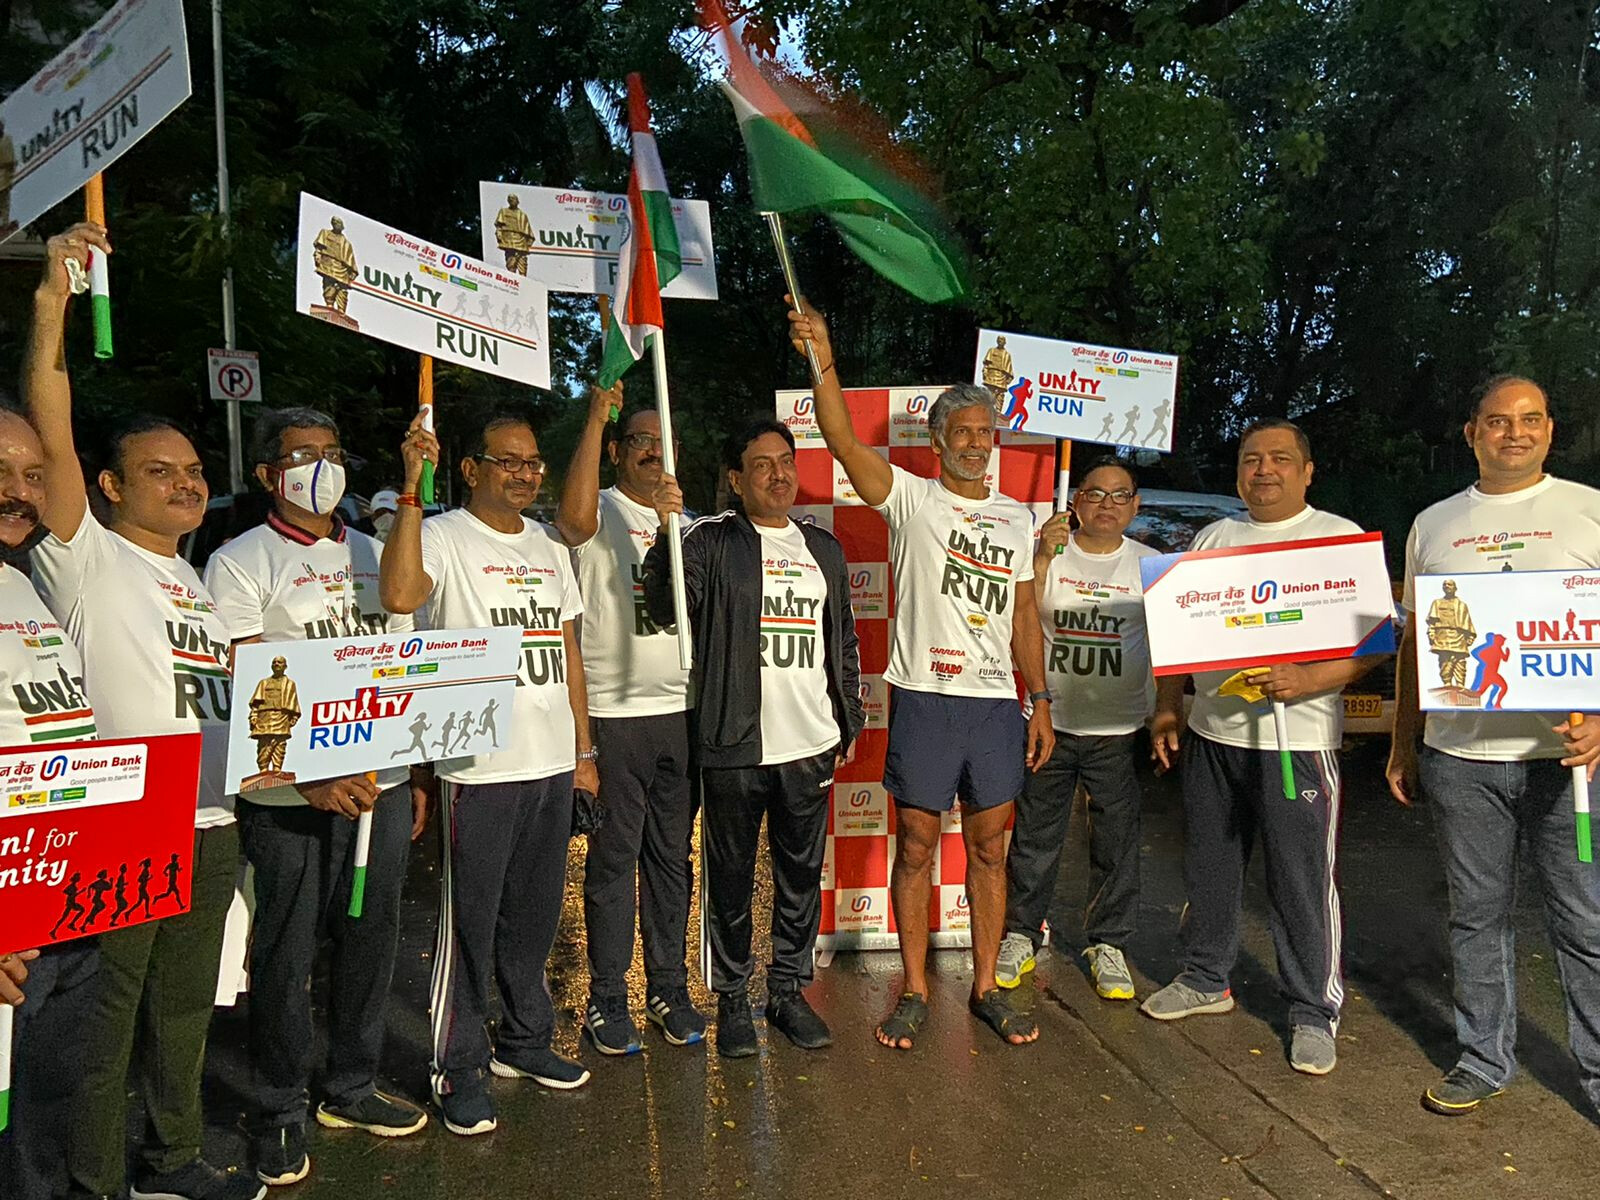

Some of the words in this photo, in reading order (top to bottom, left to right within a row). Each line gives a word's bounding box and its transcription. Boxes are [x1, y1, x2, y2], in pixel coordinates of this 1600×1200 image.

[21, 98, 84, 163] UNITY
[80, 94, 138, 168] RUN
[384, 232, 420, 251] यूनियन
[539, 224, 611, 250] UNITY
[363, 265, 442, 308] UNITY
[464, 263, 493, 278] Union
[495, 273, 520, 288] Bank
[436, 322, 499, 365] RUN
[1154, 359, 1173, 367] Bank
[229, 368, 243, 392] P
[1039, 369, 1101, 394] UNITY
[1038, 396, 1083, 417] RUN
[947, 531, 1015, 567] UNITY
[940, 563, 1008, 615] RUN
[1176, 590, 1222, 609] यूनियन
[1224, 586, 1246, 600] बैंक
[1282, 581, 1320, 595] Union
[1323, 577, 1357, 591] Bank
[490, 596, 561, 629] UNITY
[763, 586, 820, 618] NITY
[1284, 601, 1301, 609] Good
[1301, 599, 1322, 609] people
[1330, 596, 1345, 605] bank
[1345, 594, 1358, 603] with
[1053, 604, 1127, 633] UNITY
[1516, 608, 1600, 642] UNIT
[333, 645, 375, 661] यूनियन
[377, 642, 395, 655] बैंक
[426, 641, 457, 651] Union
[461, 638, 488, 648] Bank
[760, 634, 816, 669] RUN
[516, 648, 565, 687] UN
[1048, 643, 1122, 677] RUN
[1520, 653, 1593, 677] RUN
[12, 662, 88, 715] UNIT
[173, 672, 232, 722] RU
[316, 688, 411, 724] UNITY
[310, 722, 373, 750] RUN
[14, 760, 36, 775] बैंक
[71, 759, 107, 770] Union
[111, 755, 142, 767] Bank
[70, 778, 86, 786] Good
[87, 776, 107, 785] people
[838, 809, 861, 817] Union
[862, 809, 883, 817] Bank
[39, 828, 78, 857] for
[839, 915, 862, 923] Union
[862, 914, 883, 922] Bank
